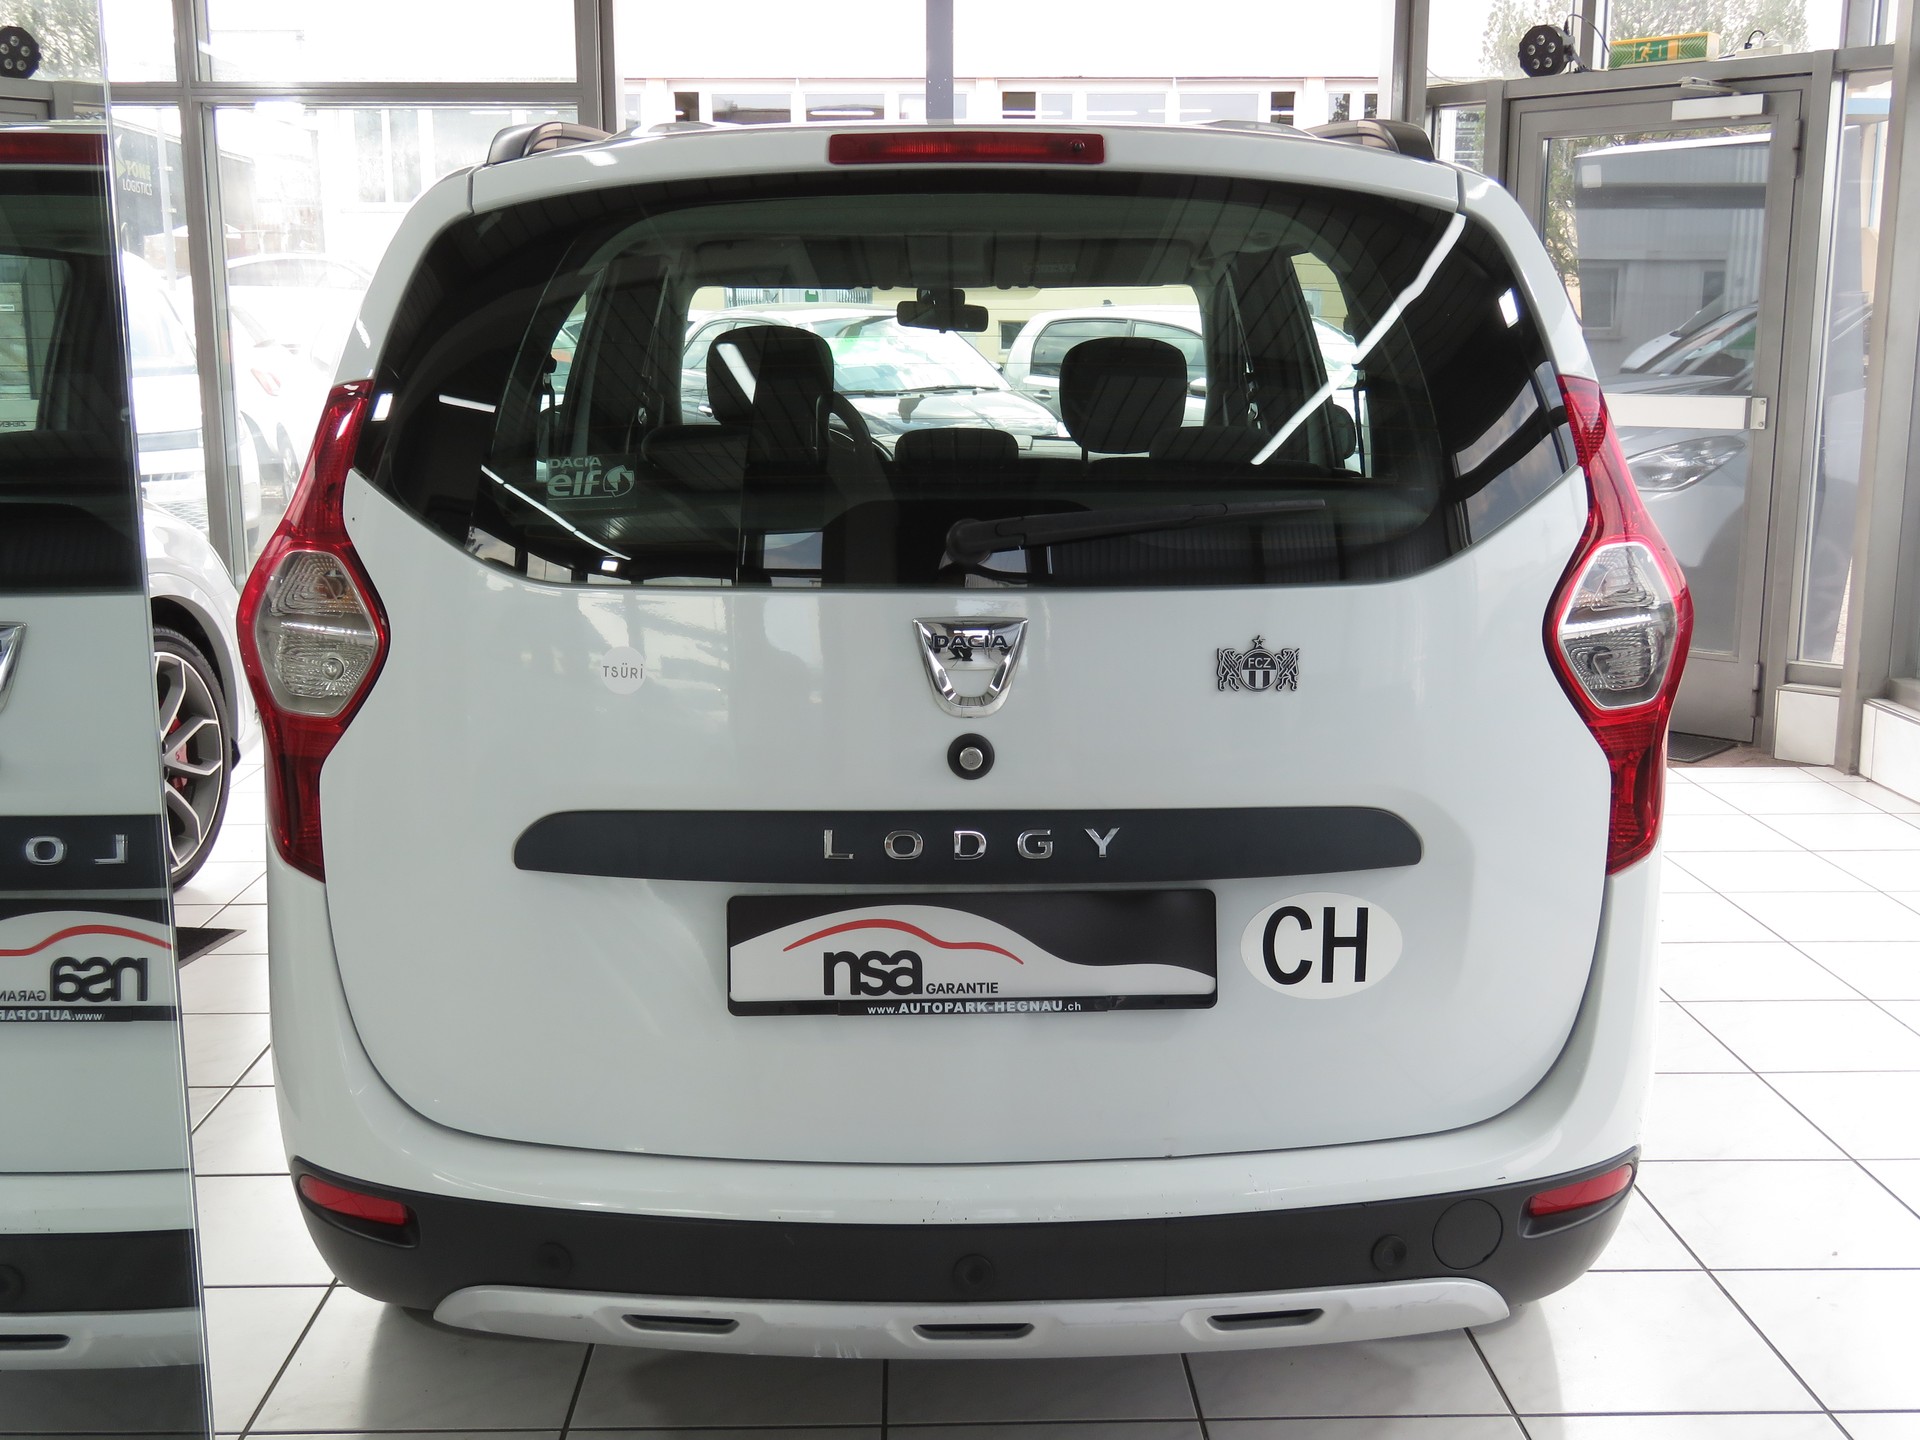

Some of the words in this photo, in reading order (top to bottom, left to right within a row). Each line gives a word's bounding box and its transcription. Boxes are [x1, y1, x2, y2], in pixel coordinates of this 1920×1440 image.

[122, 179, 152, 195] LOGISTICS
[551, 457, 602, 469] DACIA
[547, 470, 602, 496] elf
[933, 635, 1008, 648] DACIA
[1247, 657, 1272, 668] FCZ
[823, 827, 1120, 860] LODGY
[1262, 905, 1369, 985] CH
[823, 950, 923, 996] nsa
[926, 981, 999, 995] GARANTIE
[867, 1000, 1082, 1015] www.AUTOPARK-HEGNAU.ch
